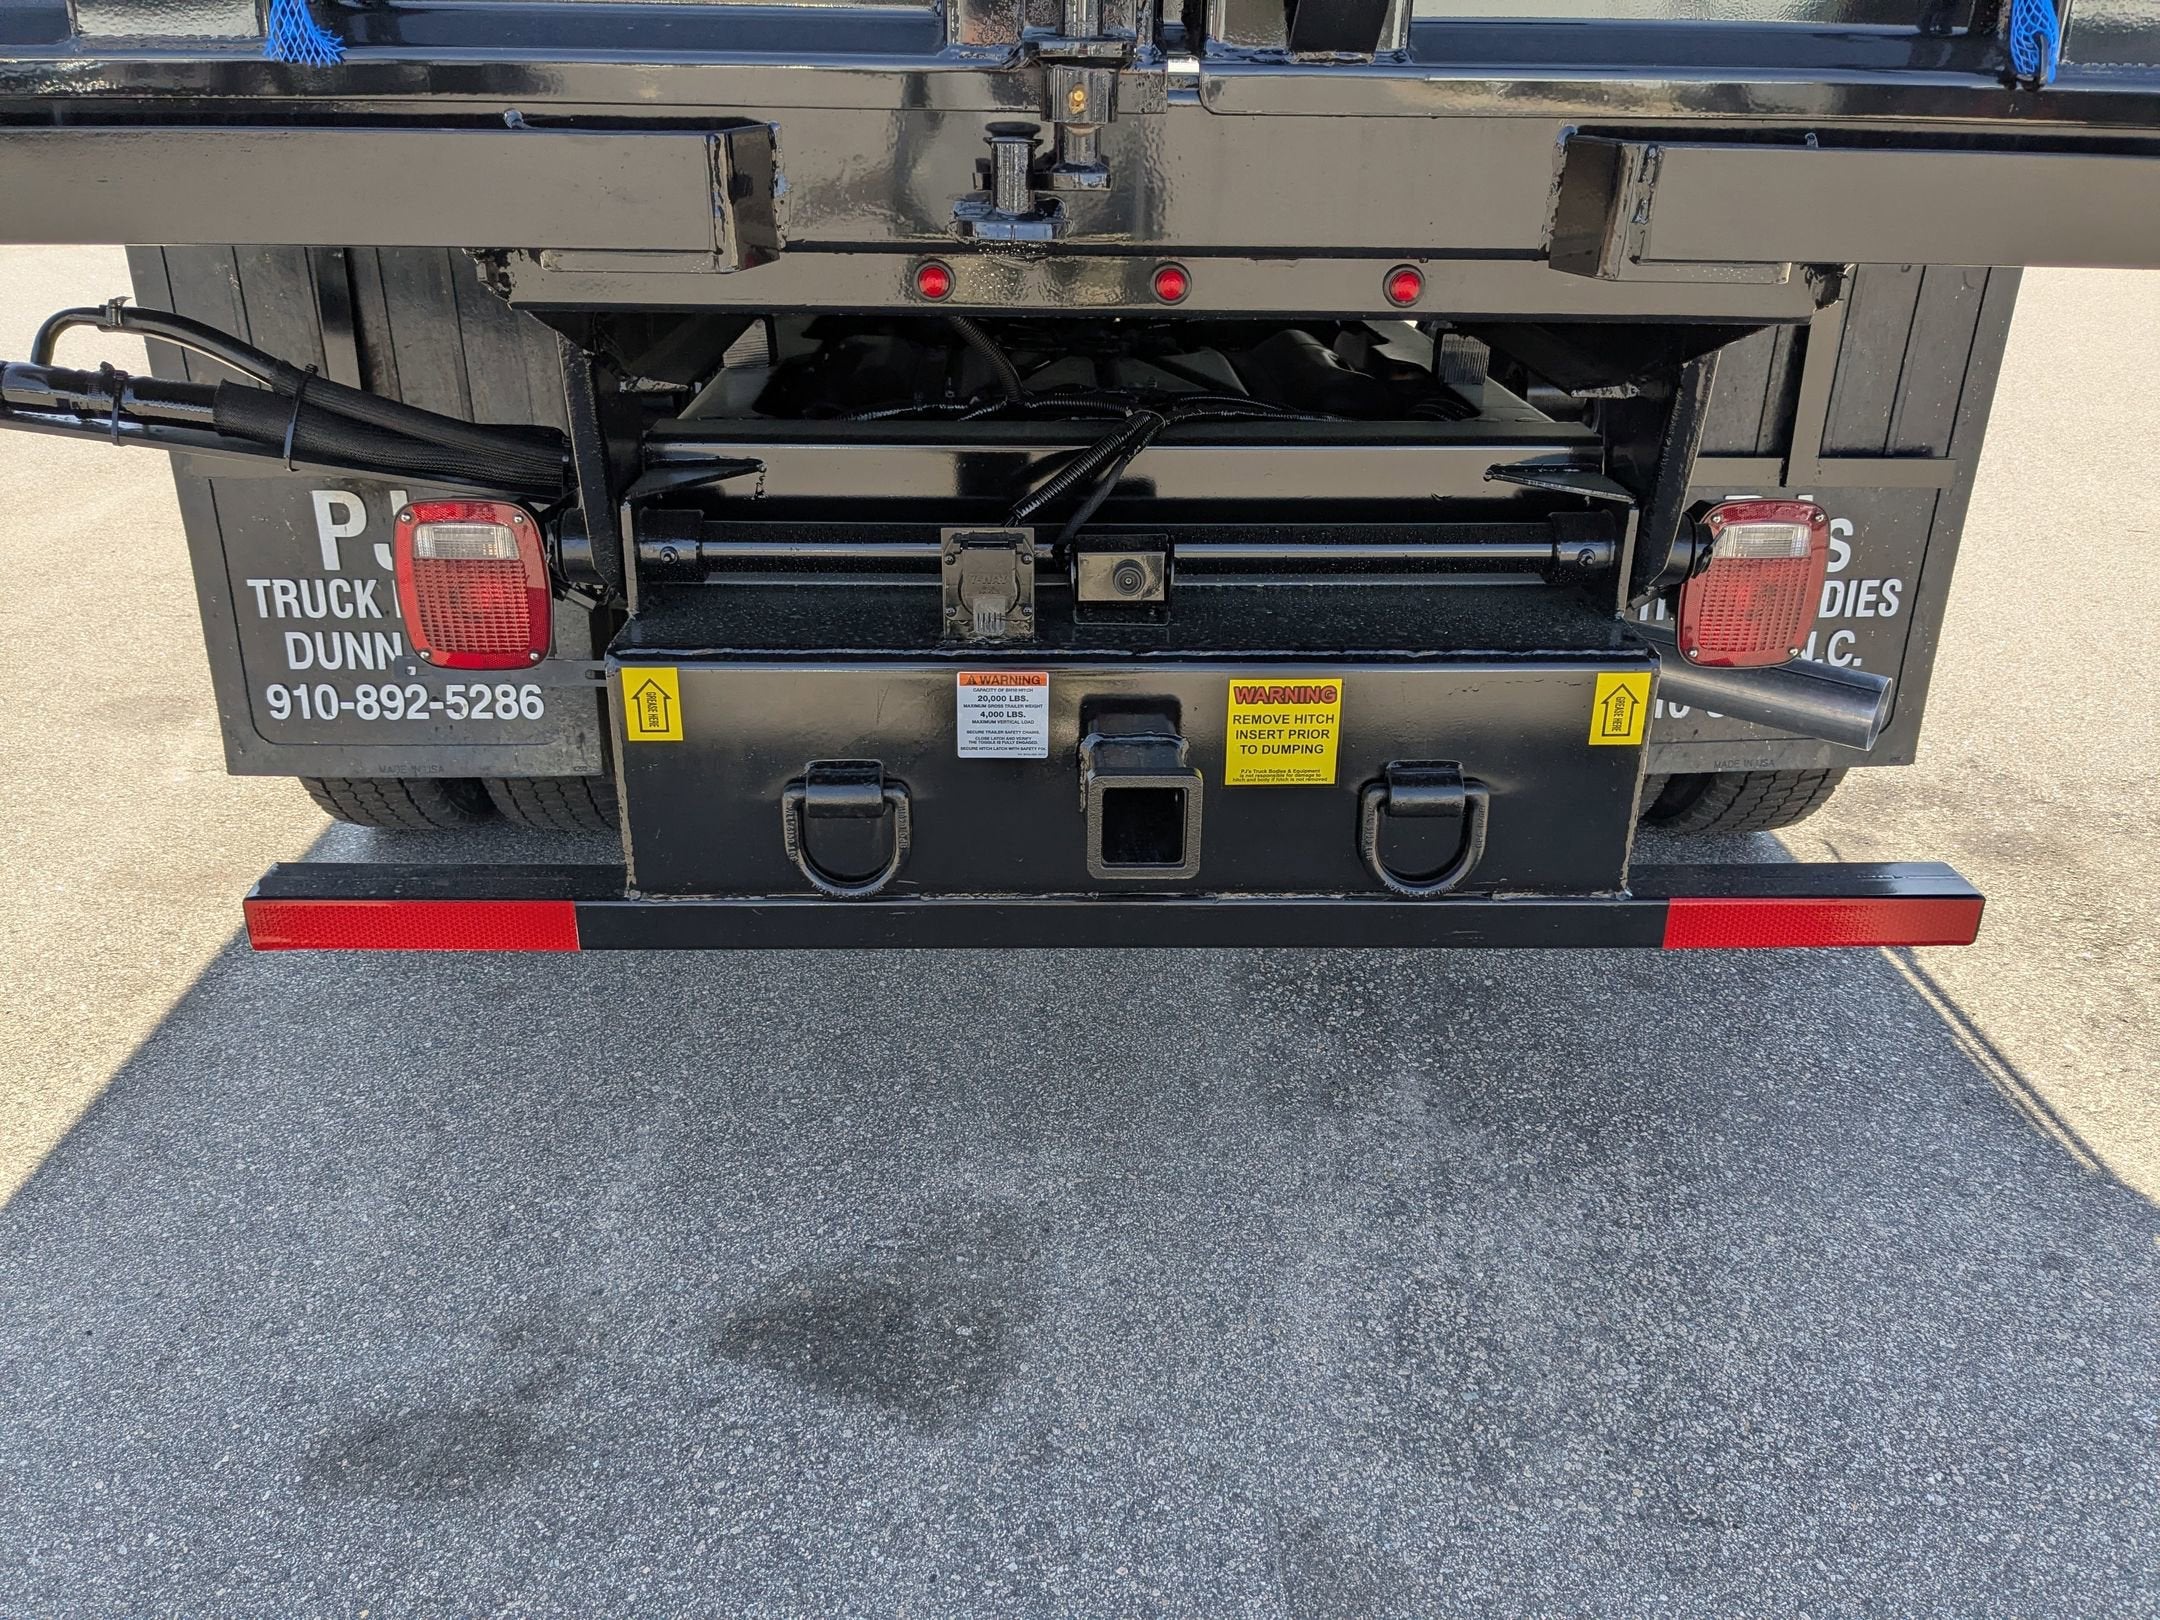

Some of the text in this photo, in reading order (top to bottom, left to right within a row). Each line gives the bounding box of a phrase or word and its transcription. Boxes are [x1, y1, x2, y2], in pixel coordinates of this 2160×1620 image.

[247, 578, 381, 619] TRUCK
[1819, 579, 1903, 618] DIES
[979, 675, 1041, 685] WARNING
[266, 683, 544, 720] 910-892-5286
[1234, 686, 1337, 704] WARNING
[646, 692, 659, 728] GREASE HERE
[1612, 696, 1625, 732] GREASE HERE
[1233, 714, 1335, 725] REMOVE HITCH
[1236, 730, 1330, 740] INSERT PRIOR
[1240, 744, 1324, 754] TO DUMPING
[1714, 759, 1740, 769] MADE
